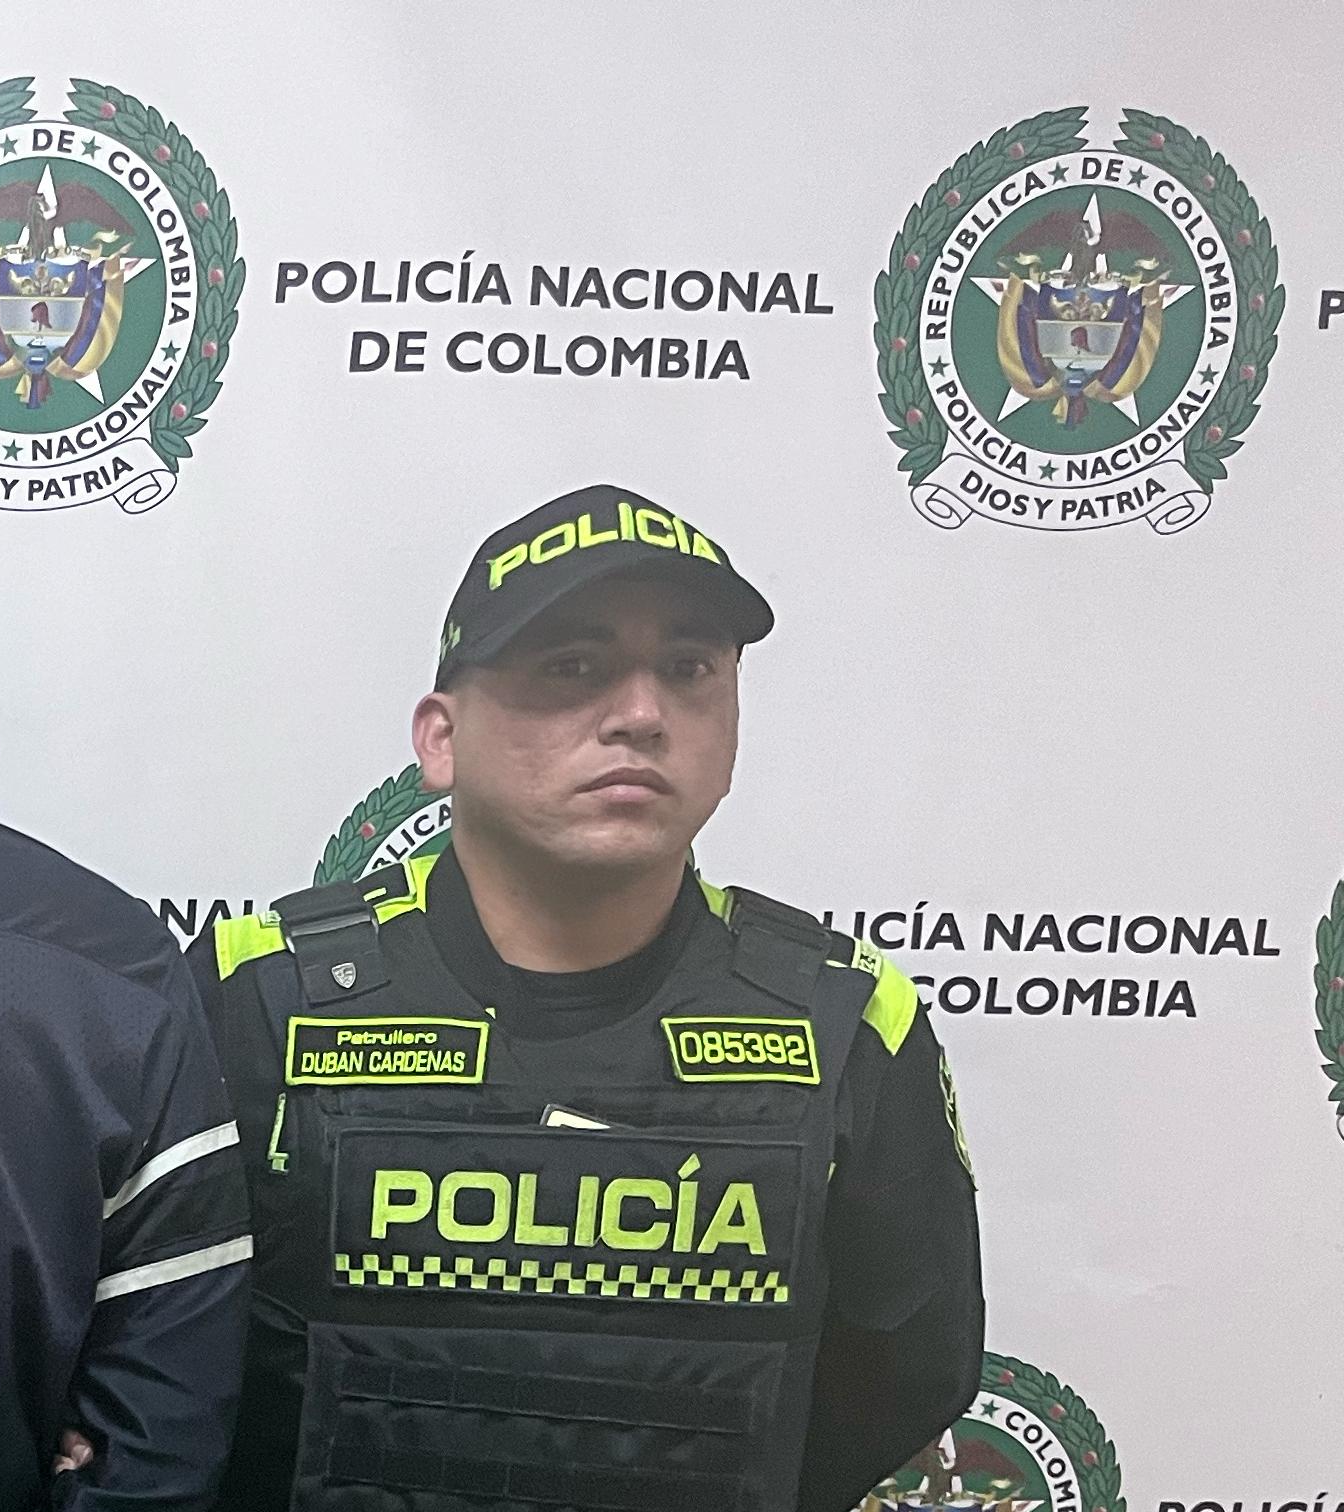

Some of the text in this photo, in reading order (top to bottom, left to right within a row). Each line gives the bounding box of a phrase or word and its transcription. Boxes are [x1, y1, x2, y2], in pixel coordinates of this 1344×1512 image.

[30, 128, 75, 155] DE
[108, 151, 194, 325] COLOMBIA
[1079, 157, 1123, 183] DE
[1153, 180, 1233, 350] COLOMBIA
[275, 250, 833, 314] POLICÍA NACIONAL
[349, 331, 750, 380] DE COLOMBIA
[31, 364, 174, 461] NACIONAL
[1065, 388, 1210, 483] NACIONAL
[26, 456, 131, 502] PATRIA
[1058, 478, 1163, 523] PATRIA
[984, 913, 1280, 956] NACIONAL
[337, 1029, 438, 1045] Patrullero
[679, 1031, 809, 1066] 085392
[301, 1050, 466, 1074] DUBAN CARDENAS
[370, 1153, 767, 1256] POLICÍA
